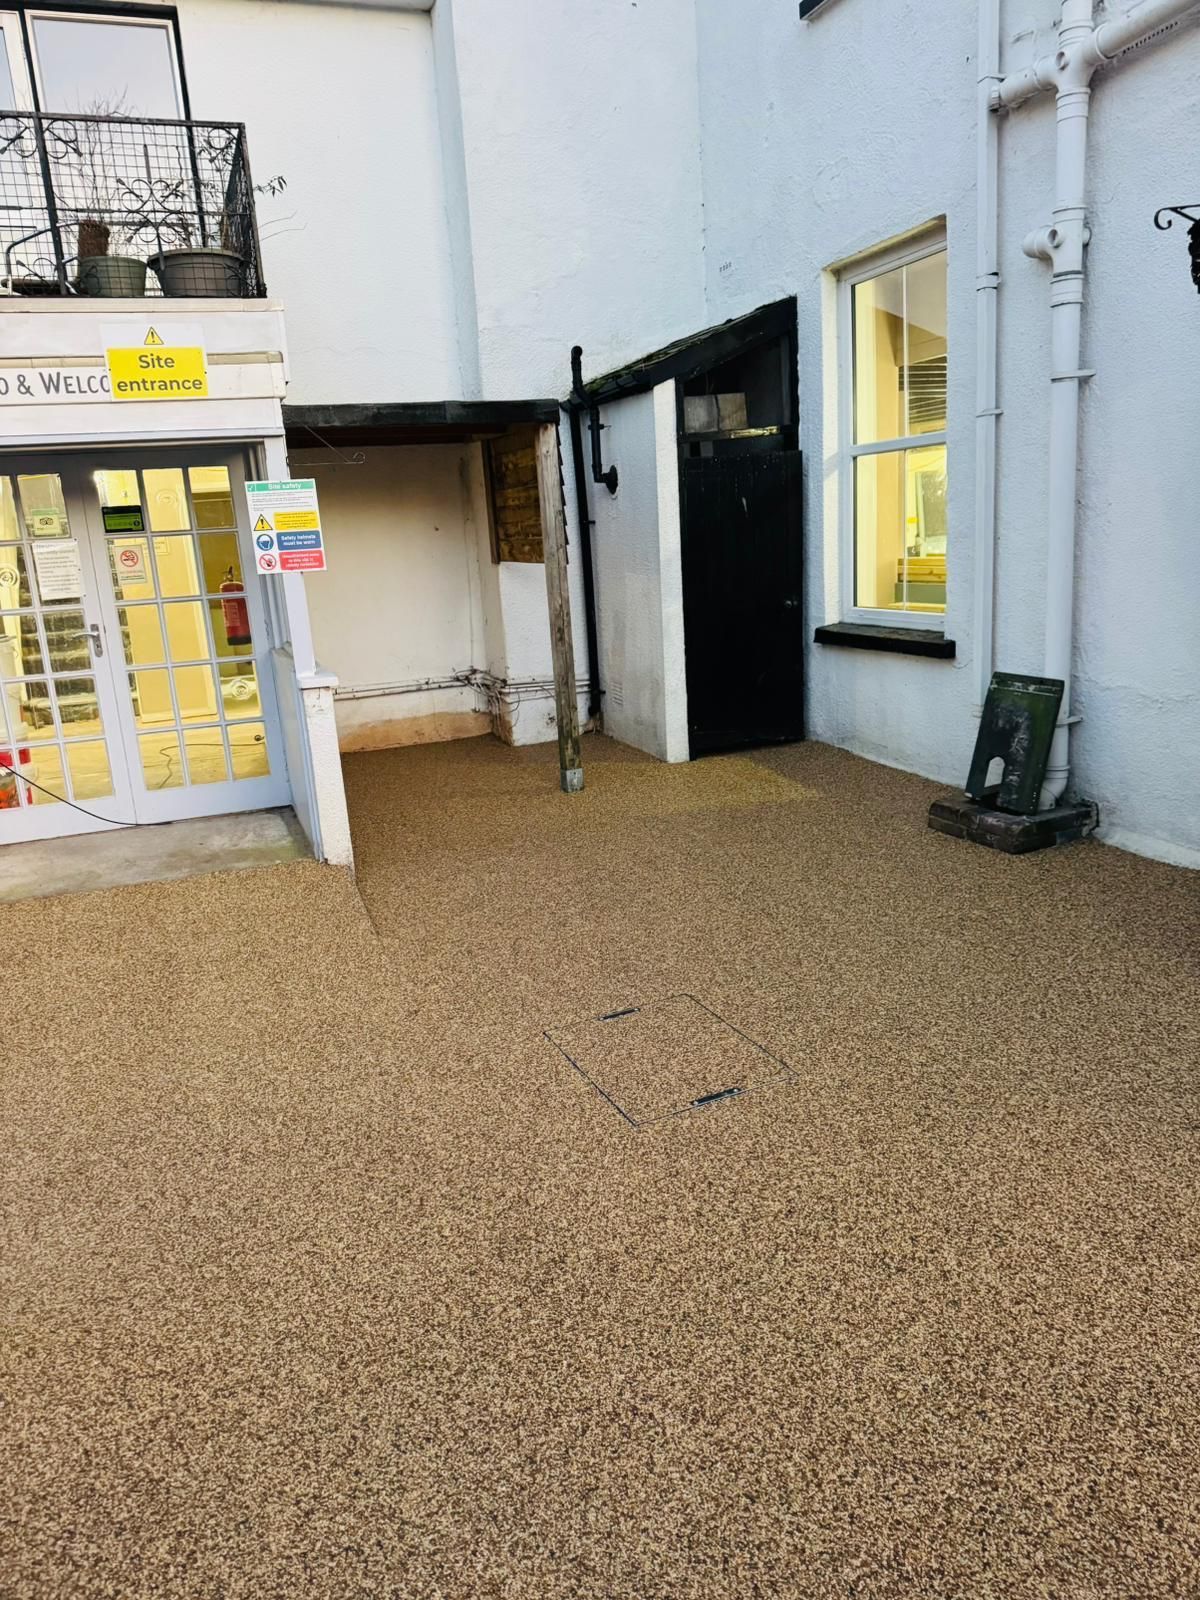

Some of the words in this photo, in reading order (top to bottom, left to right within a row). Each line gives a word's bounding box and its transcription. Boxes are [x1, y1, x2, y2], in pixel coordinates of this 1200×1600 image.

[138, 353, 175, 369] Site
[17, 374, 35, 397] &
[117, 378, 203, 392] entrance
